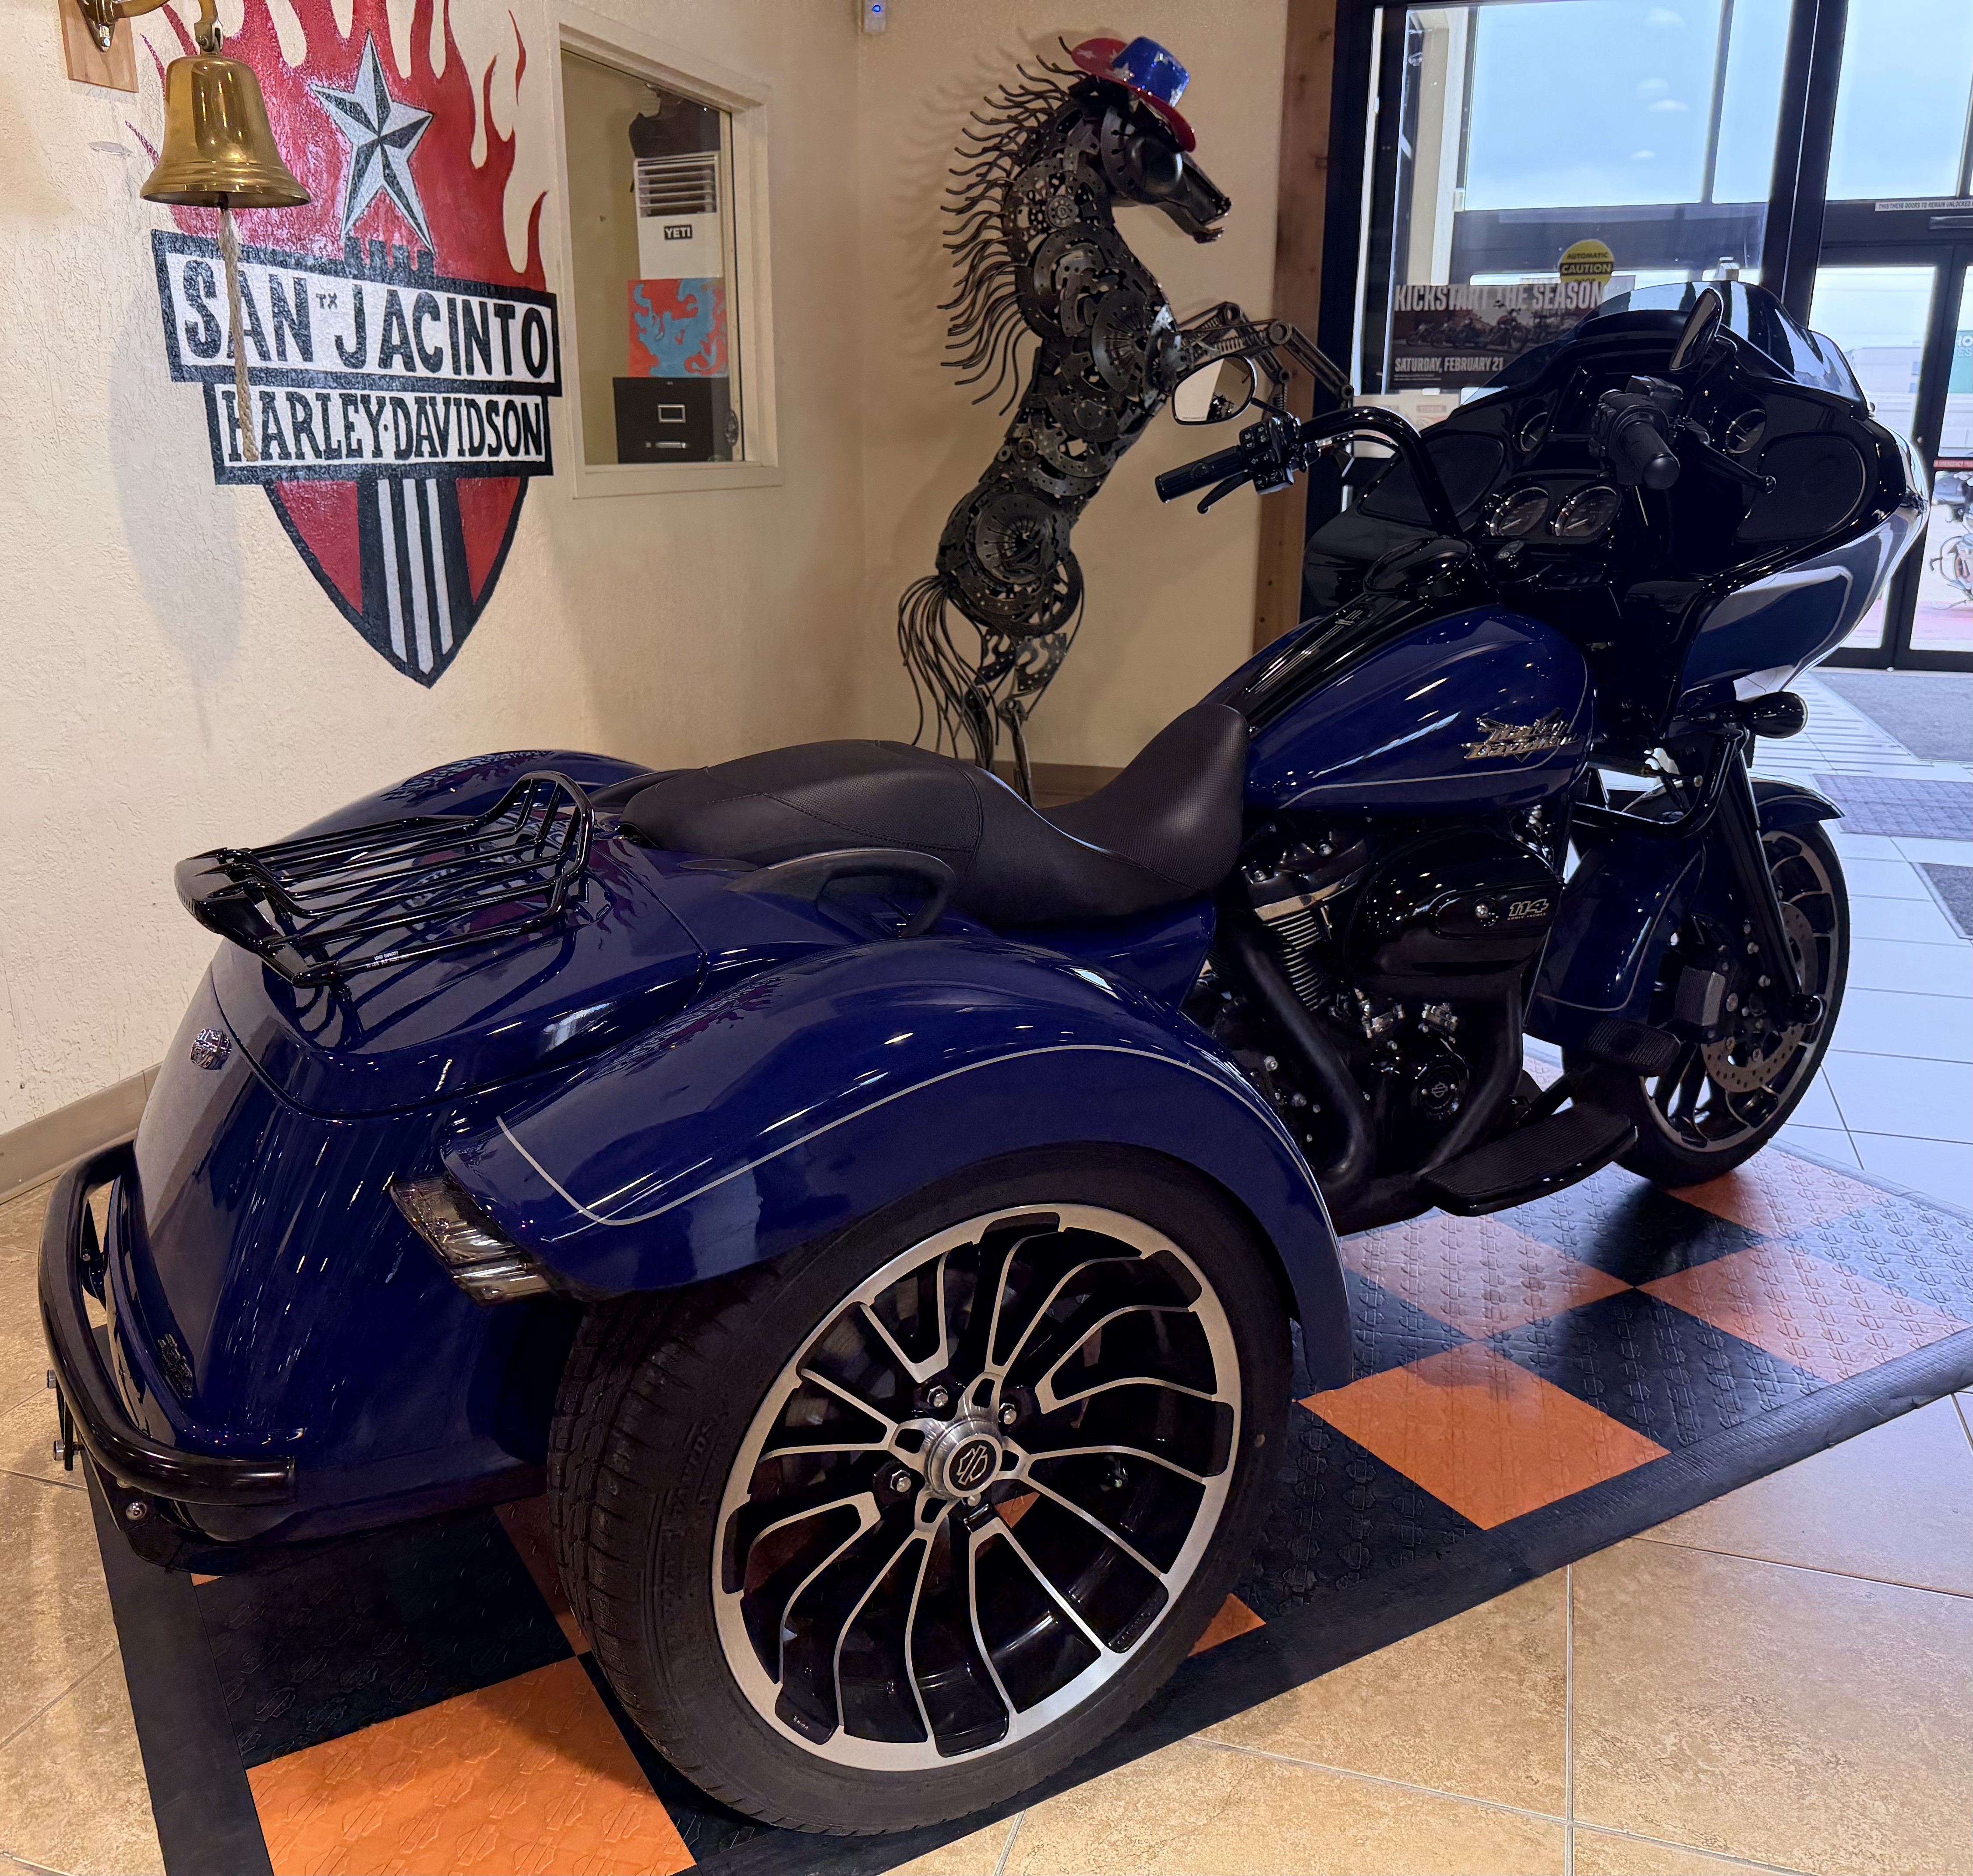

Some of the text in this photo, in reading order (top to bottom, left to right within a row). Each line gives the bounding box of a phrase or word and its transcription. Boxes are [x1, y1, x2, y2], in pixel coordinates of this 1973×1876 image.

[665, 226, 691, 238] YETI
[1561, 263, 1612, 274] CAUTION
[1394, 282, 1605, 311] KICKSTART THE SEASON
[183, 259, 549, 379] SAN TX JACINTO
[1394, 356, 1504, 373] SATURDAY, FEBRUARY 21
[1508, 898, 1549, 917] 114
